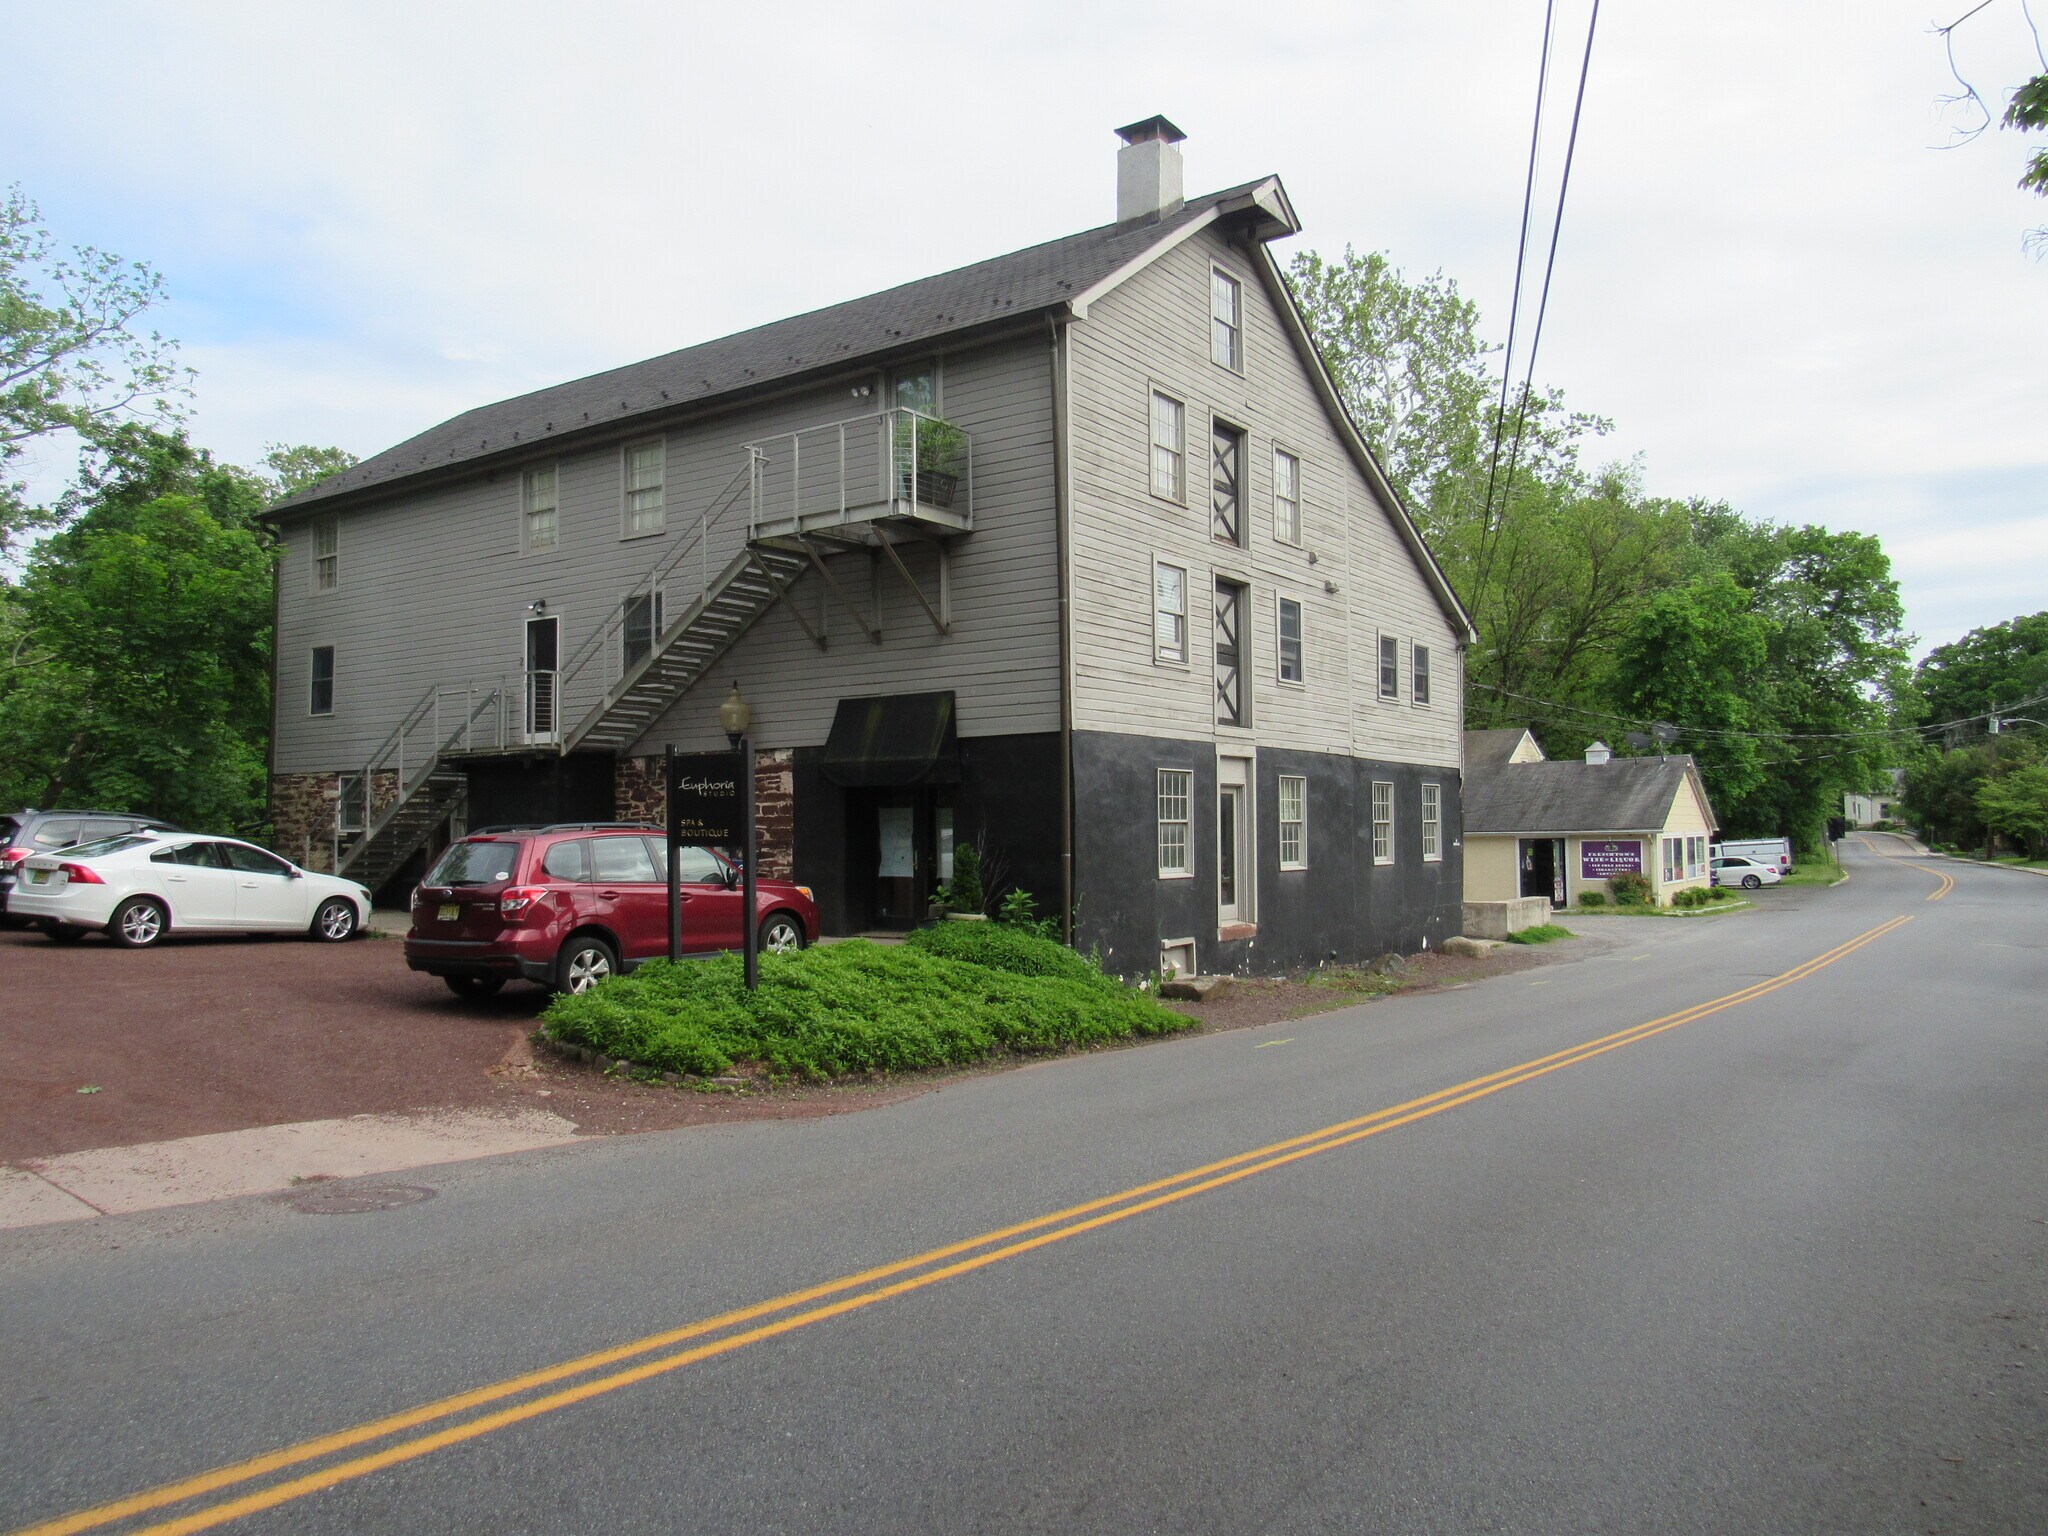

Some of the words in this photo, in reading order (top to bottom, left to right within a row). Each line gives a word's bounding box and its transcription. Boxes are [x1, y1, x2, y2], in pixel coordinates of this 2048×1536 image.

[678, 776, 735, 796] Euphoria
[681, 819, 695, 827] SPA
[681, 828, 729, 838] BOUTIQUE
